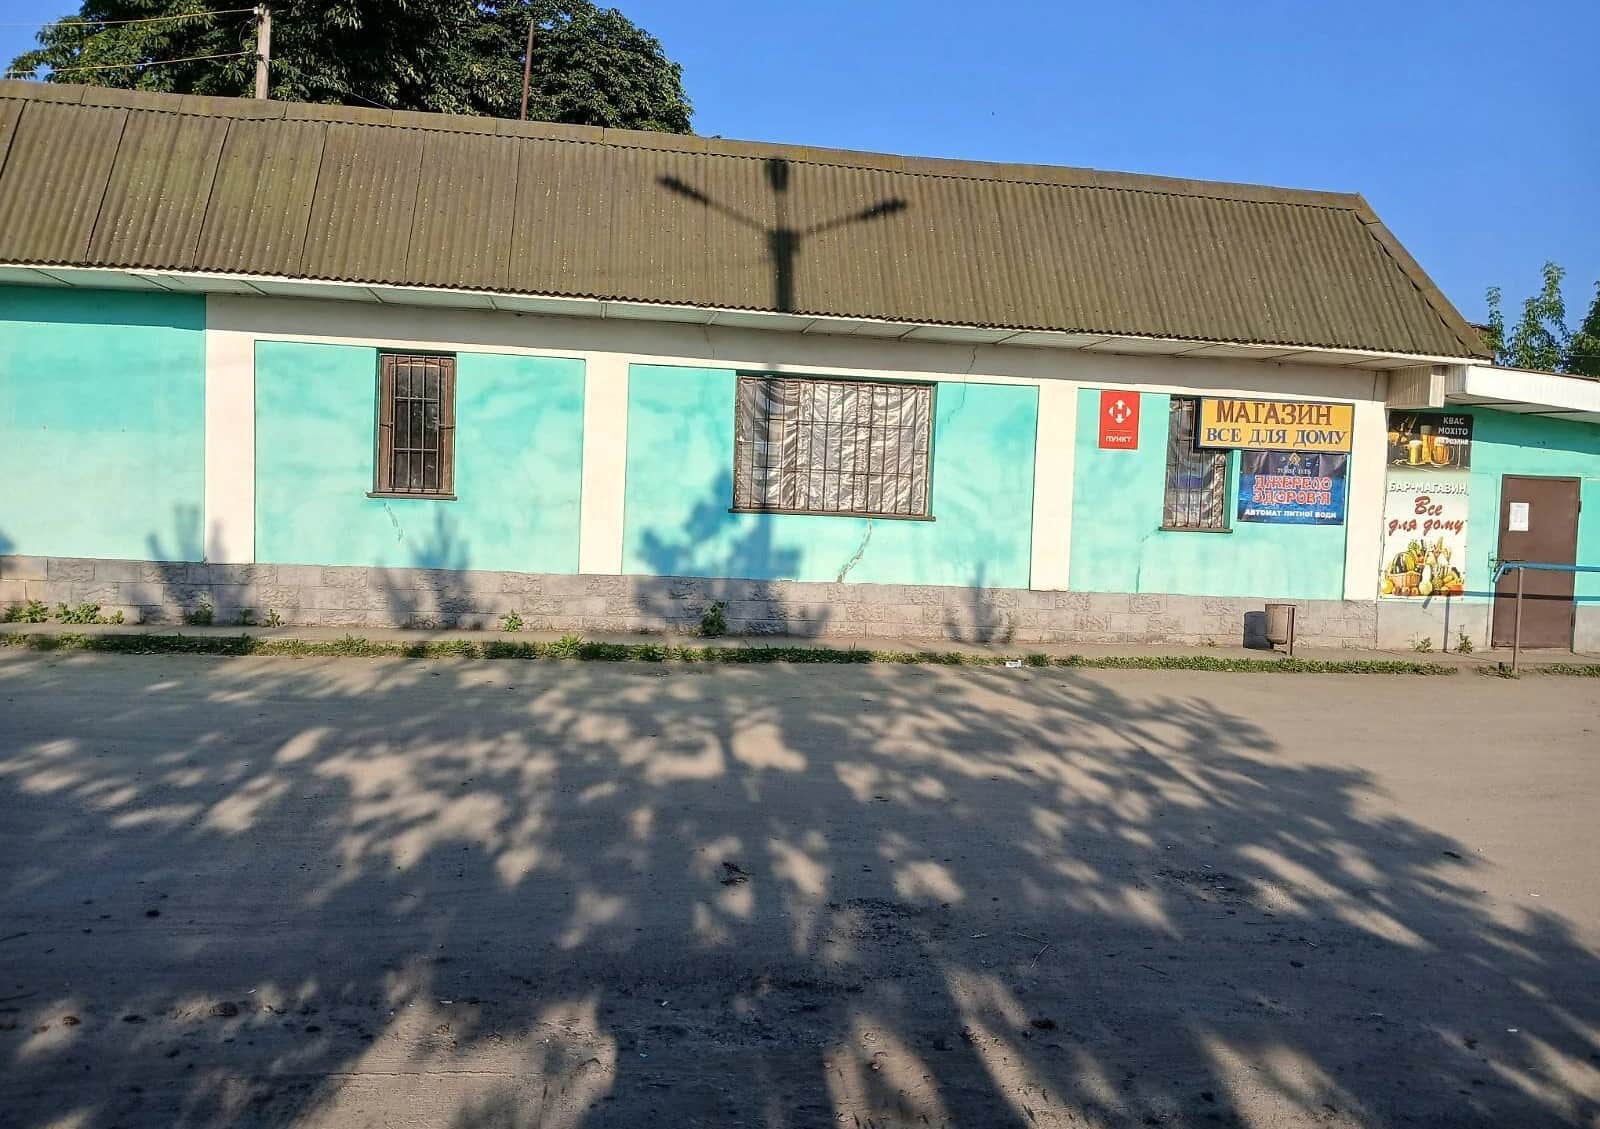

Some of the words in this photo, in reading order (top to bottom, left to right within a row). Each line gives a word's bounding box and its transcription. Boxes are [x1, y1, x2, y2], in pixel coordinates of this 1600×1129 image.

[1216, 400, 1333, 426] МАГАЗИН
[1443, 416, 1464, 425] КВАС
[1105, 435, 1132, 443] ПУНКТ
[1206, 427, 1241, 443] ВСЕ
[1248, 429, 1287, 445] ДЛЯ
[1293, 430, 1347, 447] ДОМУ
[1438, 427, 1468, 436] МОХІТО
[1255, 475, 1332, 492] ДЖЕРЕЛО
[1244, 509, 1281, 517] АВТОМАТ
[1284, 510, 1313, 518] ПИТНОЇ
[1414, 495, 1443, 516] Все
[1388, 519, 1417, 536] для
[1423, 519, 1464, 536] дому
